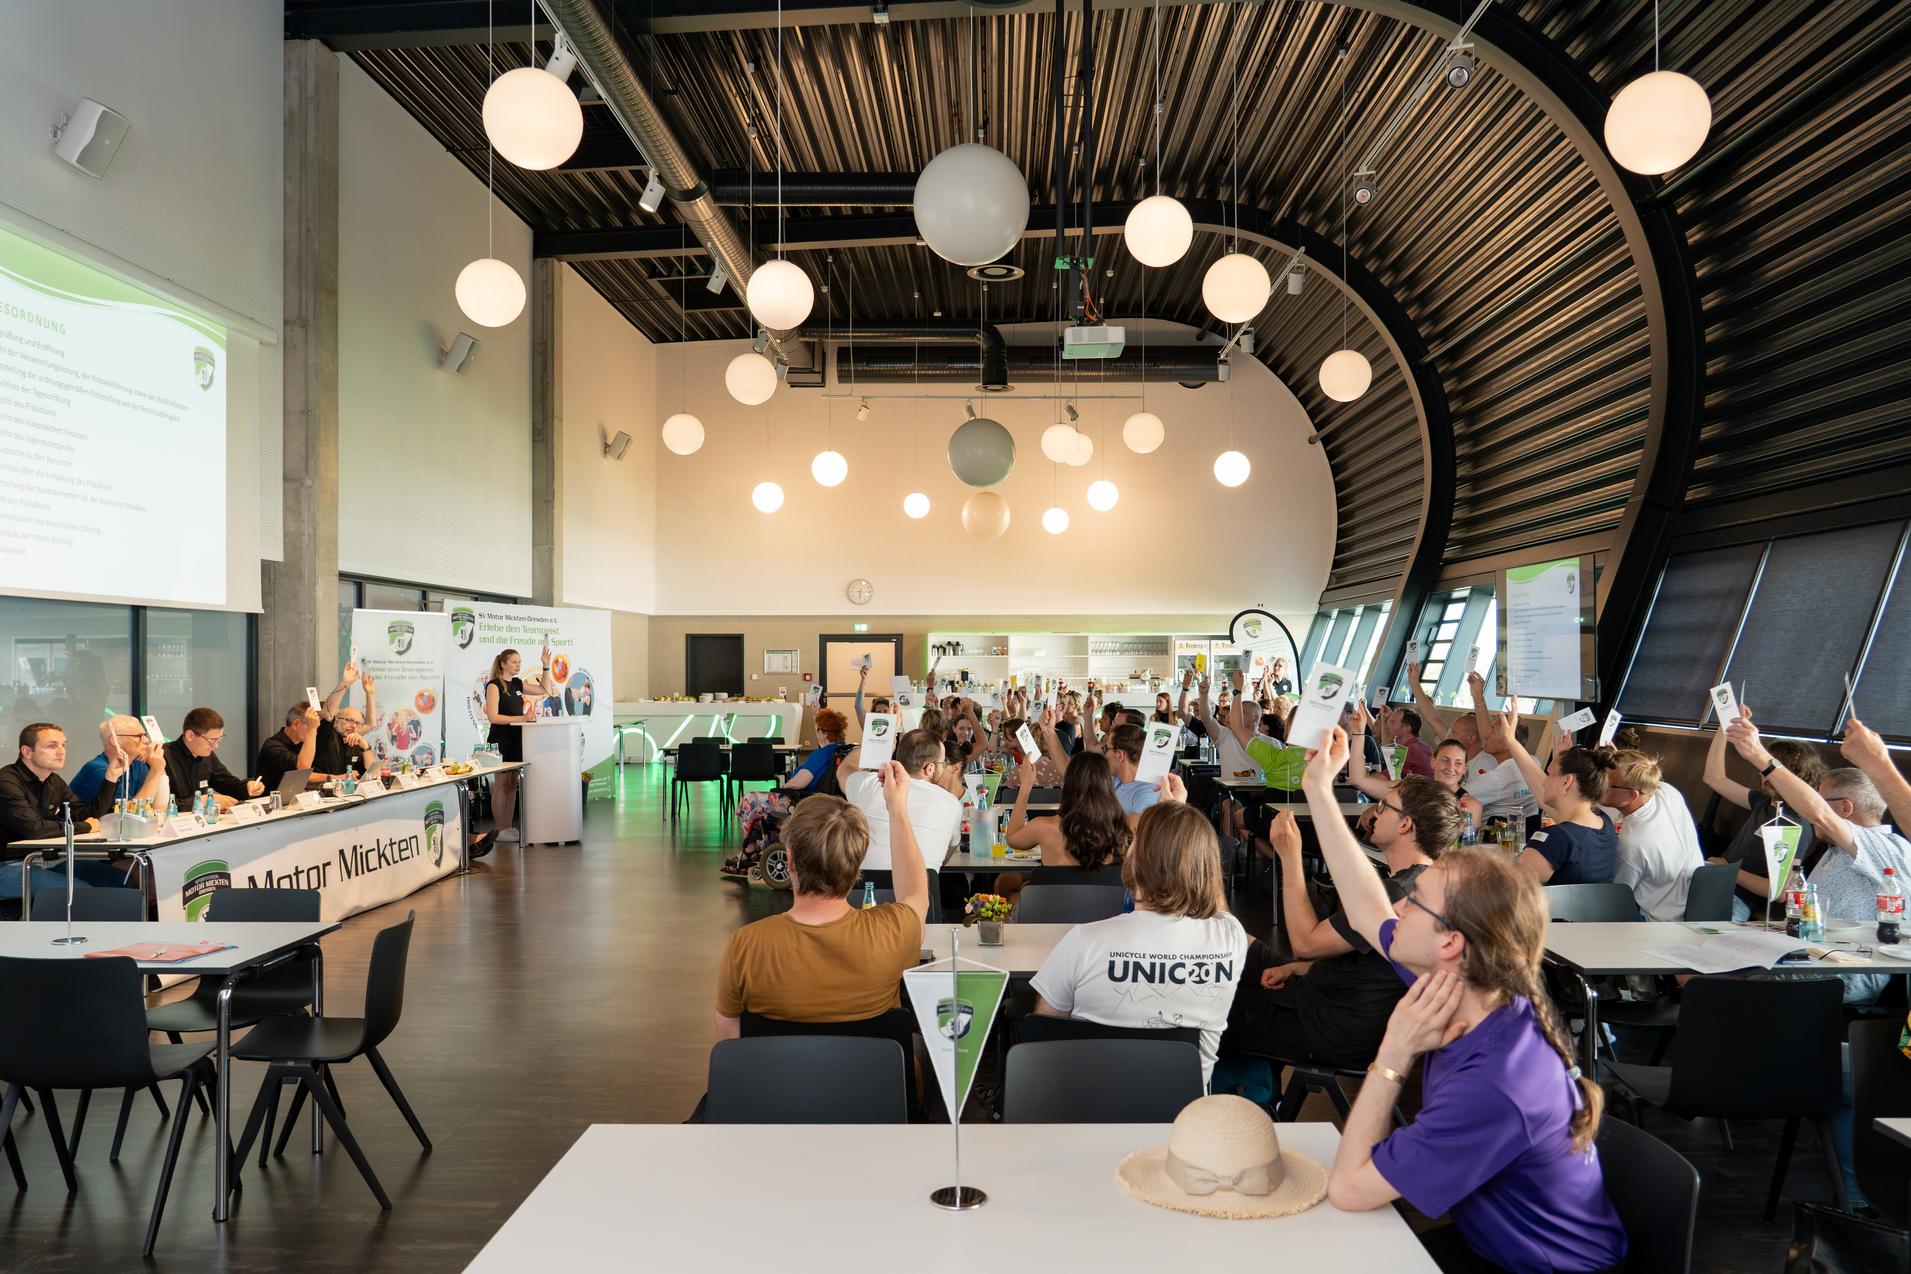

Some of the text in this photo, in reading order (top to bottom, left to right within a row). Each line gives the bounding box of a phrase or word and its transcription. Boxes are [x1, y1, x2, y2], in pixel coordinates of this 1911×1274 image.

[487, 613, 504, 621] Motor
[479, 622, 560, 636] Erlebe den Teamgeist
[479, 636, 495, 644] und
[496, 637, 508, 645] die
[510, 637, 536, 646] Freude
[551, 638, 573, 649] Sport!
[338, 834, 421, 882] Mickten
[185, 879, 229, 897] MOTOR MICKTEN
[1180, 952, 1233, 960] CHAMPIONSHIP
